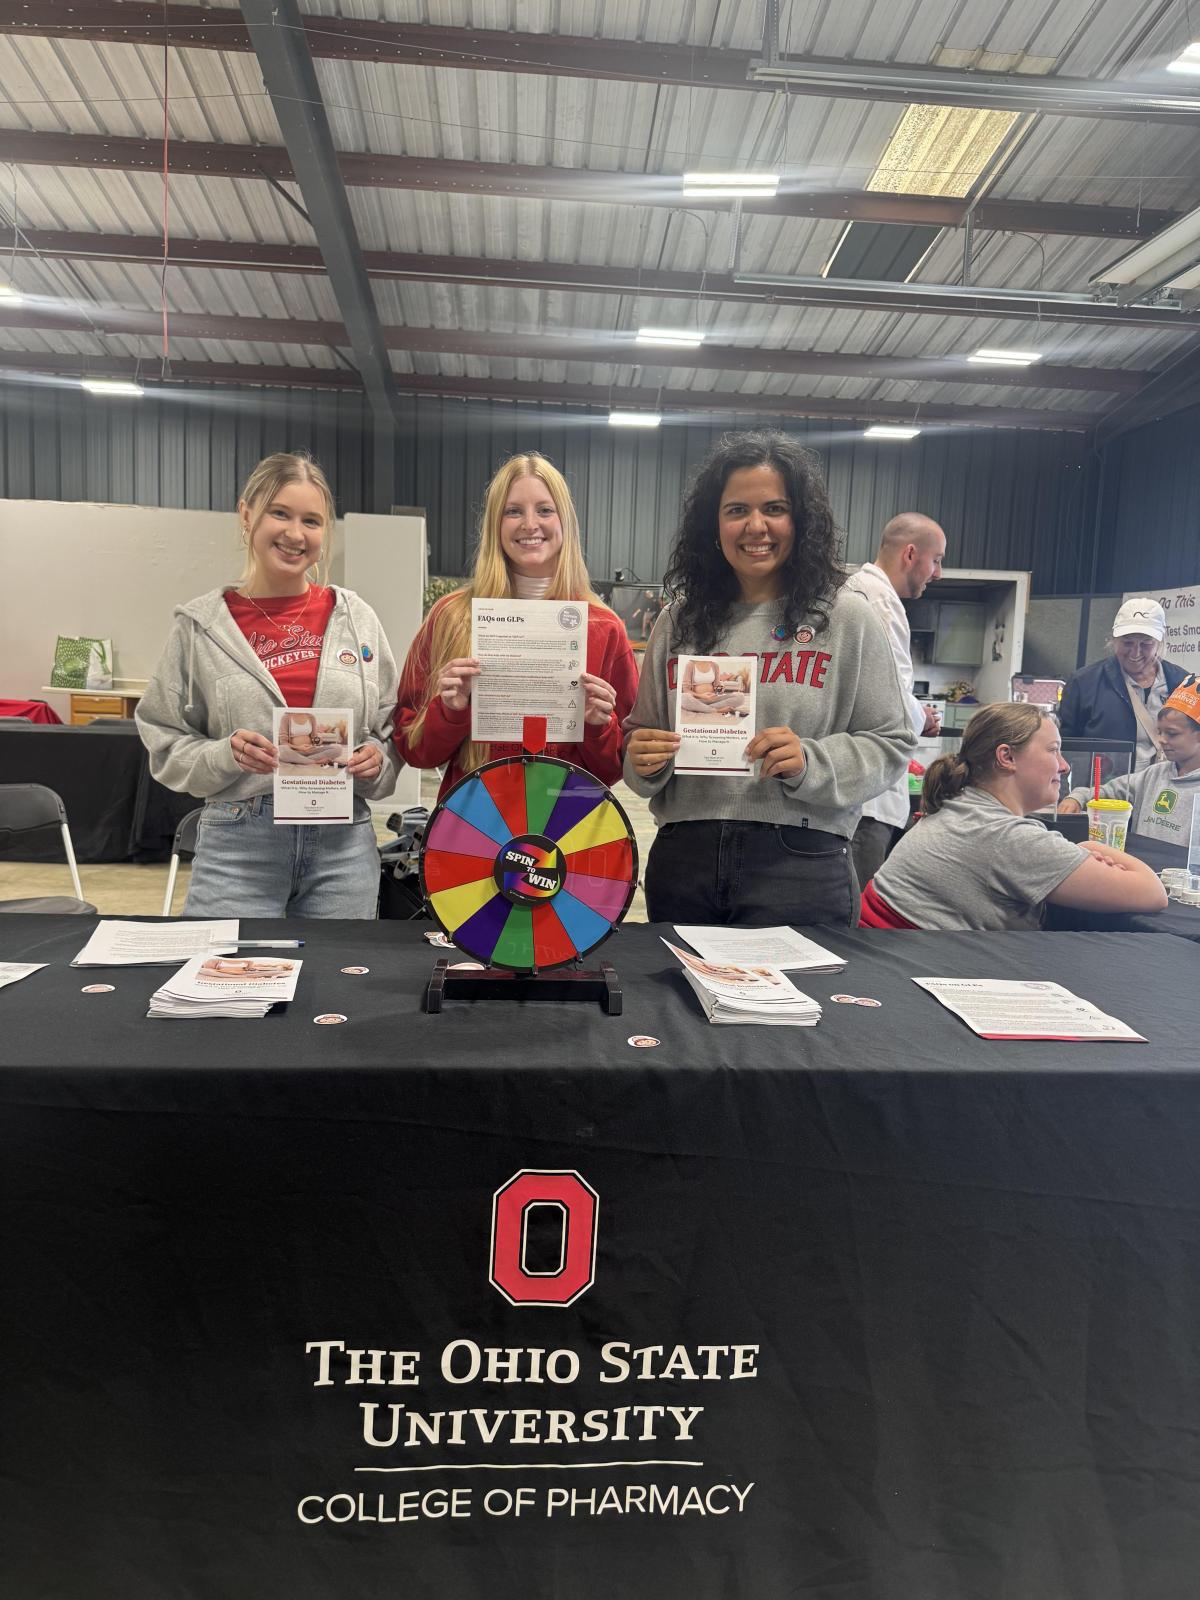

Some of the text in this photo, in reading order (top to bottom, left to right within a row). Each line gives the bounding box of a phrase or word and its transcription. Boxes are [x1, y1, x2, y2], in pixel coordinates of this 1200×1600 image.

[1175, 594, 1196, 609] This
[478, 615, 496, 623] FAQs
[1164, 626, 1181, 637] Test
[742, 650, 833, 689] TATE
[505, 850, 536, 867] SPIN
[528, 873, 557, 890] WIN
[305, 1339, 760, 1387] THE OHIO STATE
[359, 1402, 705, 1448] UNIVERSITY
[297, 1482, 756, 1524] COLLEGE OF PHARMACY
